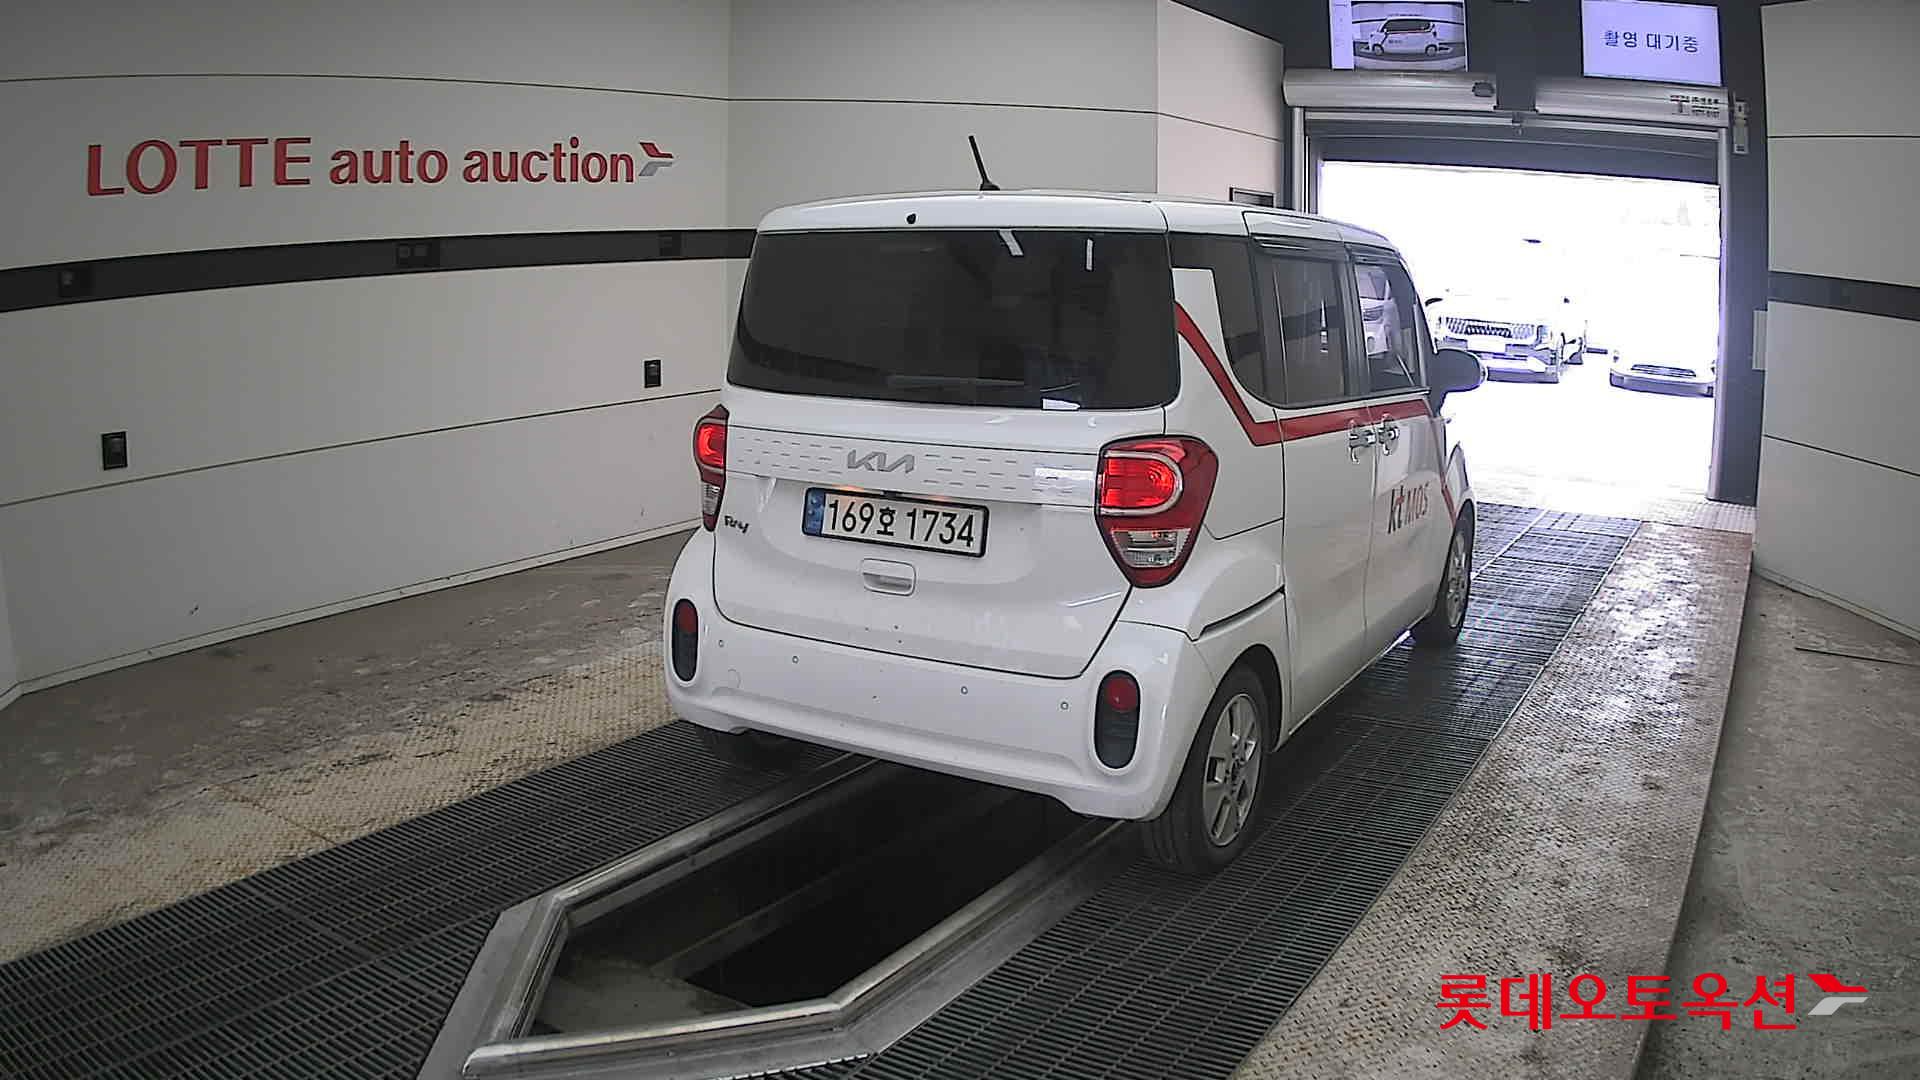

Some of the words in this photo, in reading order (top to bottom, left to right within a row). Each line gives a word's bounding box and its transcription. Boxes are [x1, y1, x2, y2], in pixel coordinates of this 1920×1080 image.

[1605, 30, 1638, 48] 촬영
[1645, 32, 1698, 53] 대기중
[88, 137, 312, 196] LOTTE
[329, 140, 449, 184] auto
[462, 137, 636, 184] auction
[828, 499, 897, 537] 169호
[906, 507, 974, 547] 1734
